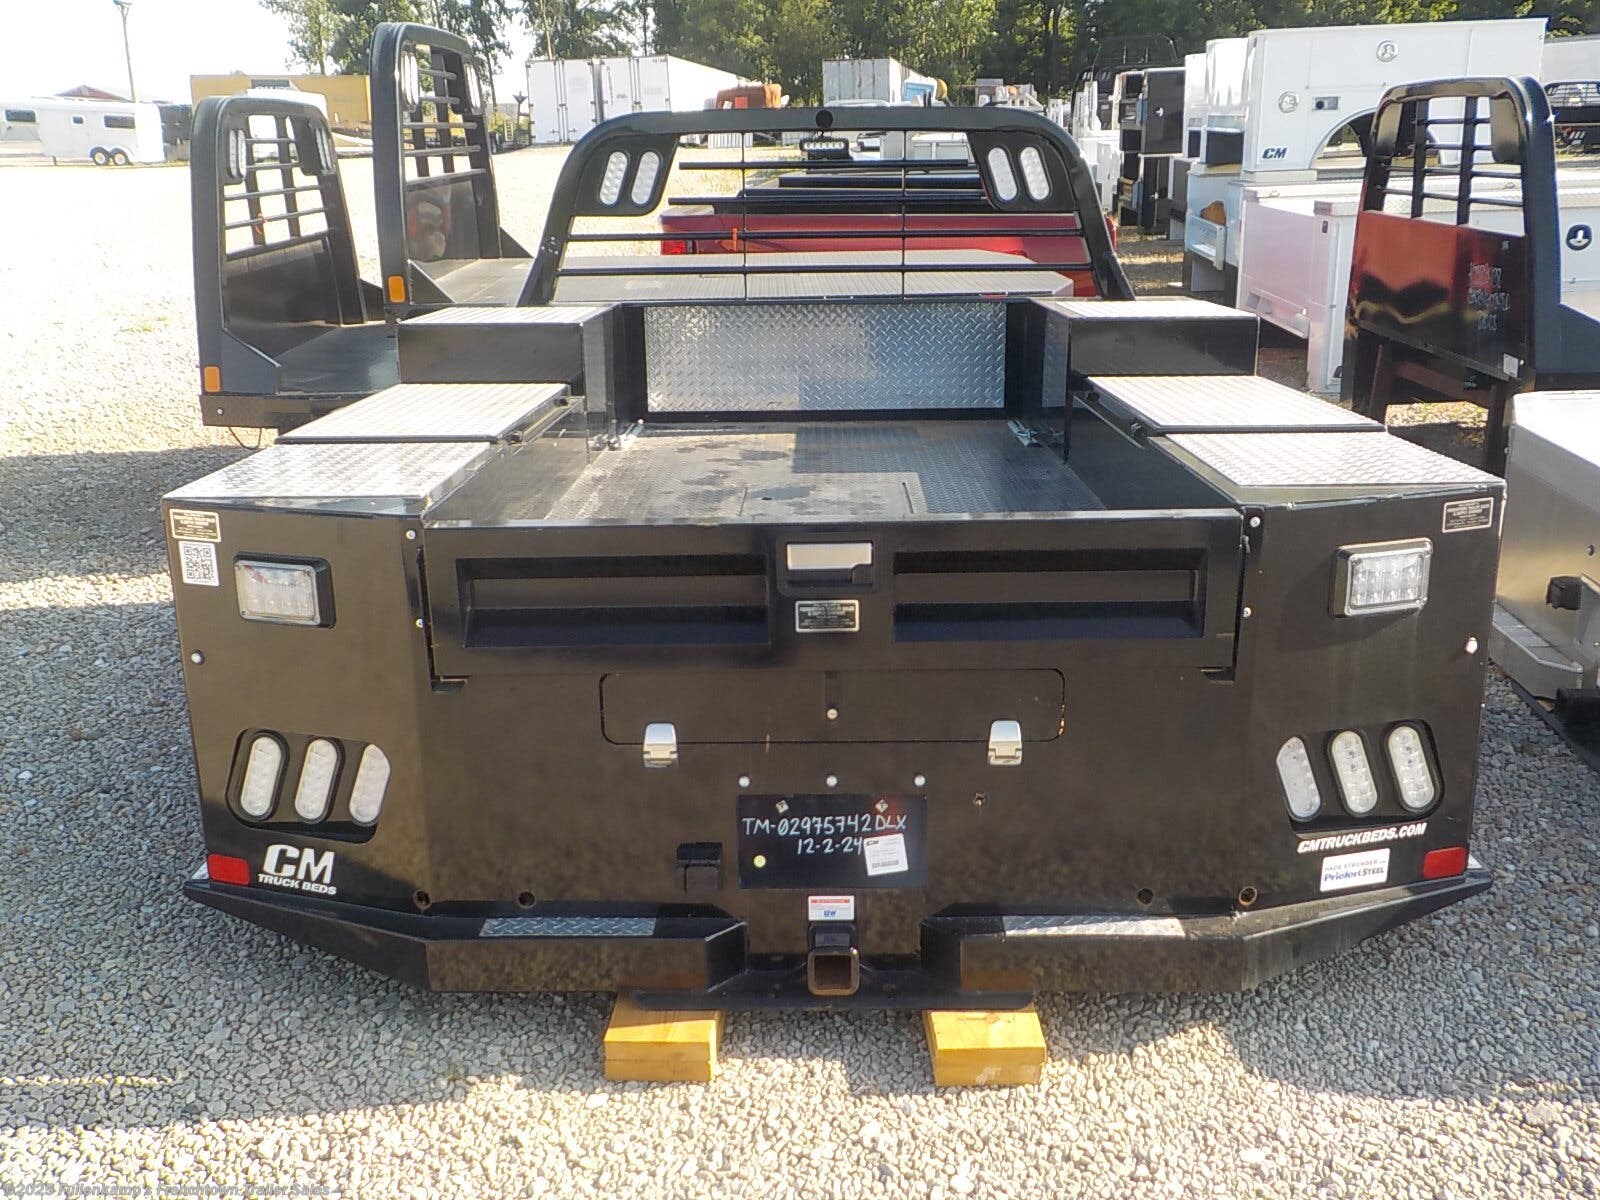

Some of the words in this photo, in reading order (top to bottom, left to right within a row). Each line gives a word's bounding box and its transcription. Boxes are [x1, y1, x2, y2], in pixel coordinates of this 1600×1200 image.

[1262, 147, 1287, 159] CM
[796, 836, 863, 855] 12-2-24
[1297, 822, 1427, 854] CMTRUCKBEDS.COM
[263, 844, 335, 884] CM
[257, 873, 300, 889] TRUCK
[301, 881, 337, 895] BEDS
